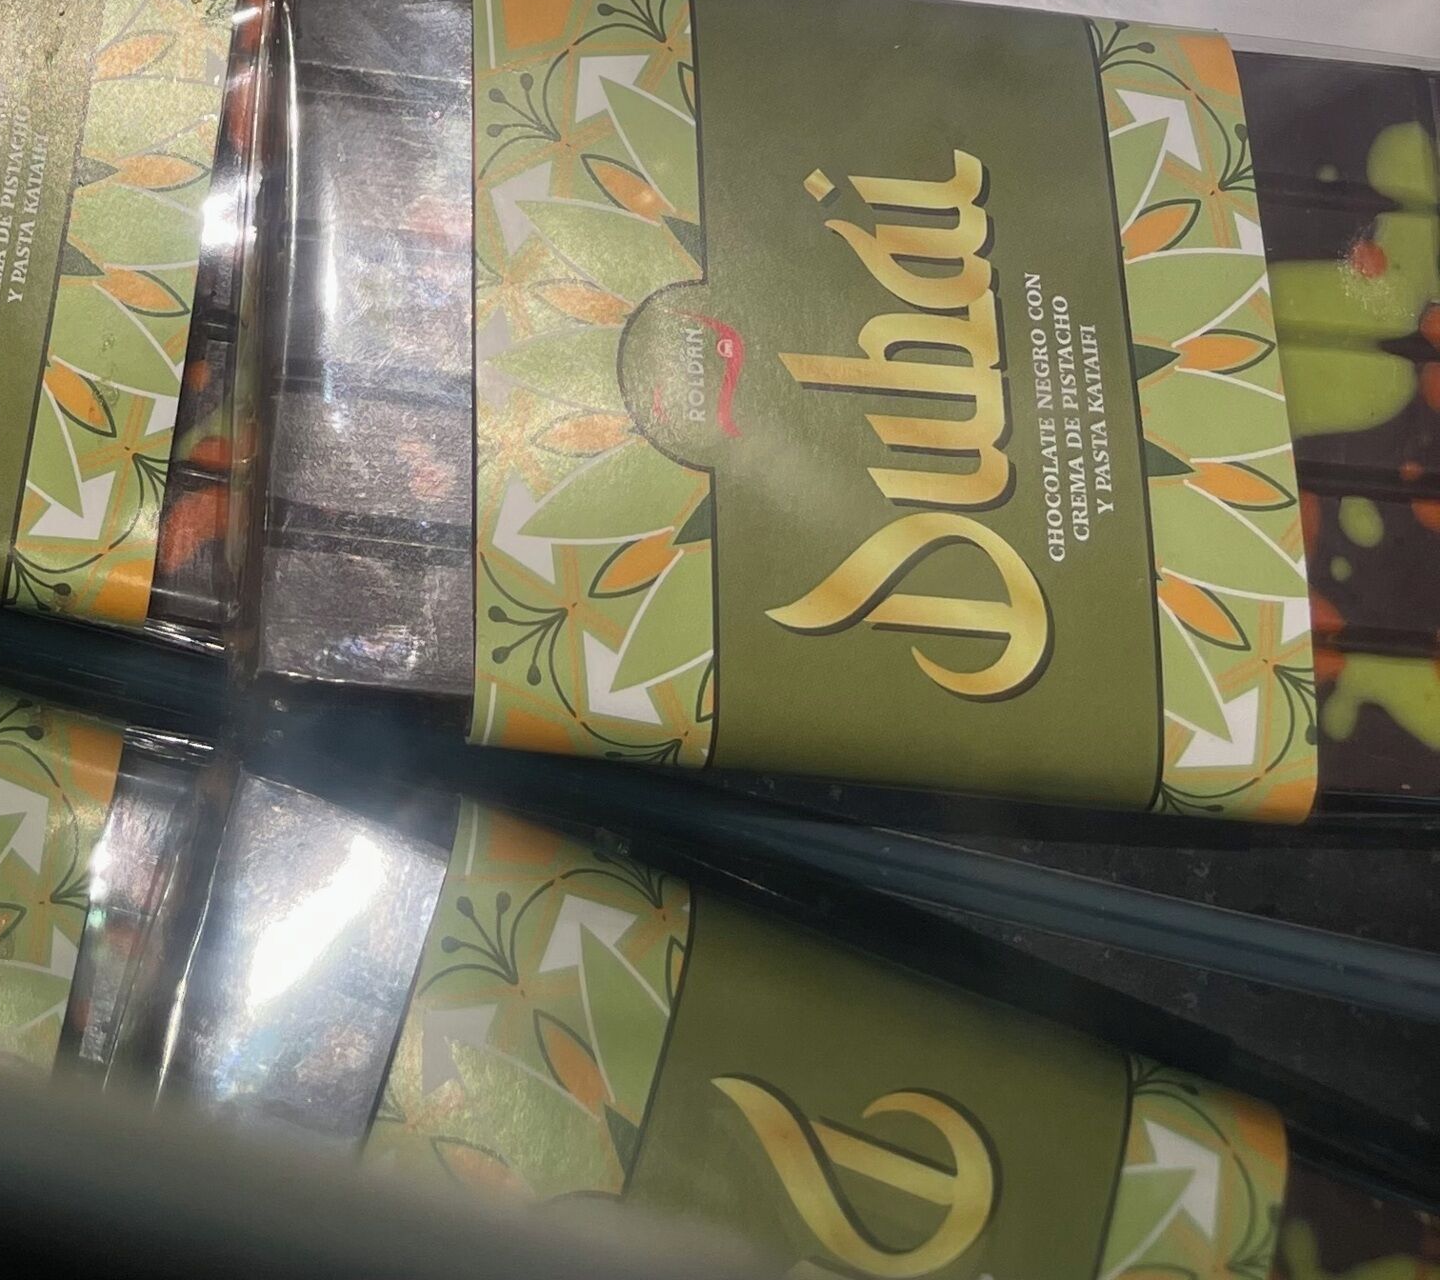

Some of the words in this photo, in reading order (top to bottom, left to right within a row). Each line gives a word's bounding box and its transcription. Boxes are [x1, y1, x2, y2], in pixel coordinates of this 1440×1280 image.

[10, 220, 36, 284] PASTA
[7, 289, 24, 304] Y
[1025, 273, 1043, 320] CON
[1031, 329, 1053, 409] NEGRO
[1052, 296, 1078, 410] PISTACHO
[1080, 325, 1104, 413] KATAIFI
[1065, 418, 1082, 449] DE
[1091, 420, 1111, 491] PASTA
[1039, 418, 1065, 561] CHOCOLATE
[1068, 457, 1089, 541] CREMA
[1097, 499, 1113, 514] Y
